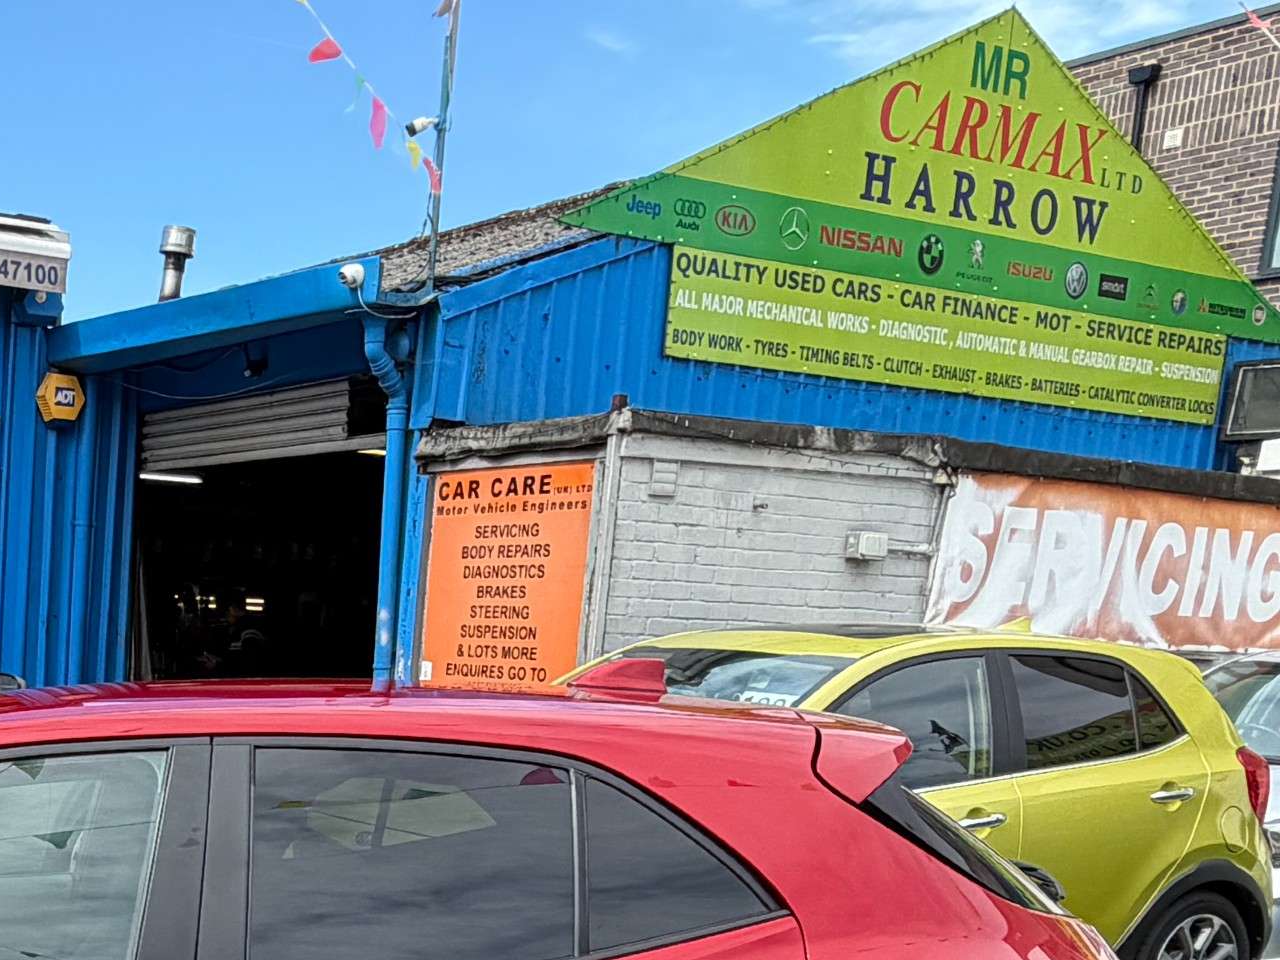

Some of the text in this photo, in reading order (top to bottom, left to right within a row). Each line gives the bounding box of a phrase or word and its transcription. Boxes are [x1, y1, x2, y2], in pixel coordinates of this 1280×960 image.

[971, 41, 1030, 100] MR
[880, 81, 1143, 194] CARMAX LTD
[860, 151, 1108, 245] HARROW
[627, 194, 661, 219] Jeep
[676, 218, 699, 232] Audi
[723, 210, 749, 231] KIA
[820, 225, 903, 257] NISSAN
[677, 252, 768, 284] QUALITY
[774, 270, 825, 293] USED
[832, 278, 882, 303] CARS
[900, 289, 936, 312] CAR
[942, 295, 1019, 325] FINANCE
[1035, 311, 1071, 333] MOT
[1087, 319, 1153, 346] SERVICE
[1157, 332, 1222, 356] REPAIRS
[675, 289, 698, 309] ALL
[702, 293, 744, 317] MAJOR
[747, 300, 823, 328] MECHANICAL
[827, 312, 869, 334] WORKS
[956, 332, 1017, 356] AUTOMATIC
[1018, 340, 1027, 357] &
[1029, 343, 1070, 363] MANUAL
[1072, 348, 1116, 371] GEARBOX
[1119, 355, 1153, 375] REPAIR
[1161, 363, 1219, 385] SUSPENSION
[672, 328, 705, 346] BODY
[708, 333, 743, 352] WORK
[754, 339, 789, 358] TYRES
[799, 346, 839, 365] TIMING
[843, 352, 874, 370] BELTS
[884, 357, 922, 376] CLUTCH
[932, 363, 977, 384] EXHAUST
[985, 372, 1022, 390] BRAKES
[1031, 378, 1081, 398] BATTERIES
[1088, 385, 1135, 405] CATALYTIC
[1137, 392, 1187, 412] CONVERTER
[1189, 398, 1215, 416] LOCKS
[55, 389, 76, 405] ADT
[439, 479, 480, 502] CAR
[491, 474, 552, 499] CARE
[576, 484, 592, 493] LTD
[437, 500, 587, 517] Motor Vehicle Engineers
[475, 523, 540, 539] SERVICING
[461, 543, 551, 560] BODY REPAIRS
[943, 498, 1280, 623] SERVICING
[463, 564, 545, 579] DIAGNOSTICS
[476, 585, 527, 599] BRAKES
[470, 605, 530, 620] STEERING
[460, 624, 537, 641] SUSPENSION
[457, 644, 538, 661] & LOTS MORE
[446, 662, 504, 680] ENQUIRES
[508, 666, 527, 681] GO
[531, 667, 547, 683] TO
